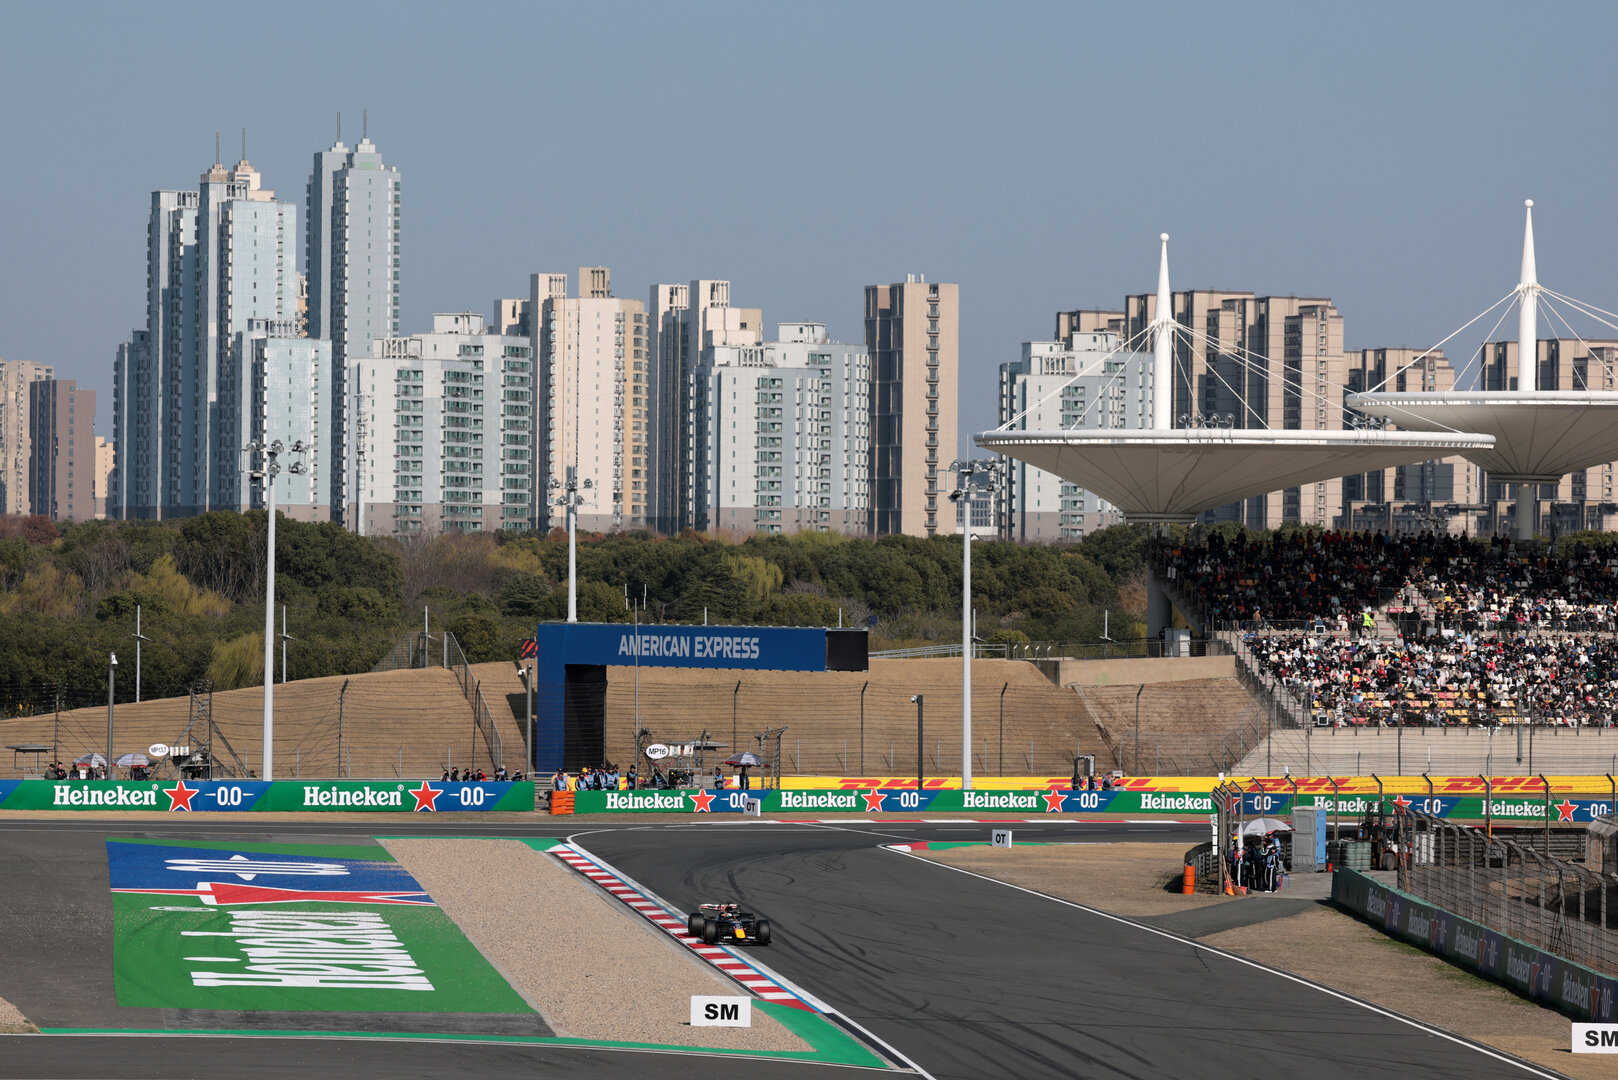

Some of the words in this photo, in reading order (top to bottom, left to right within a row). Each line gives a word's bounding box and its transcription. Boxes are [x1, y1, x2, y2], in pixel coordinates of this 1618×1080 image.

[618, 634, 690, 657] AMERICAN
[694, 636, 760, 659] EXPRESS
[1443, 777, 1551, 791] DHL
[53, 785, 156, 806] Heineken
[217, 786, 243, 806] 0.0
[303, 786, 402, 806] Heineken
[460, 786, 485, 806] 0.0
[606, 792, 684, 809] Heineken
[780, 791, 857, 809] Heineken
[900, 792, 919, 808] 0.0
[963, 791, 1037, 808] Heineken
[1079, 792, 1099, 809] 0.0
[1140, 793, 1213, 810] Heineken
[704, 1003, 739, 1020] SM
[1584, 1030, 1618, 1047] SM
